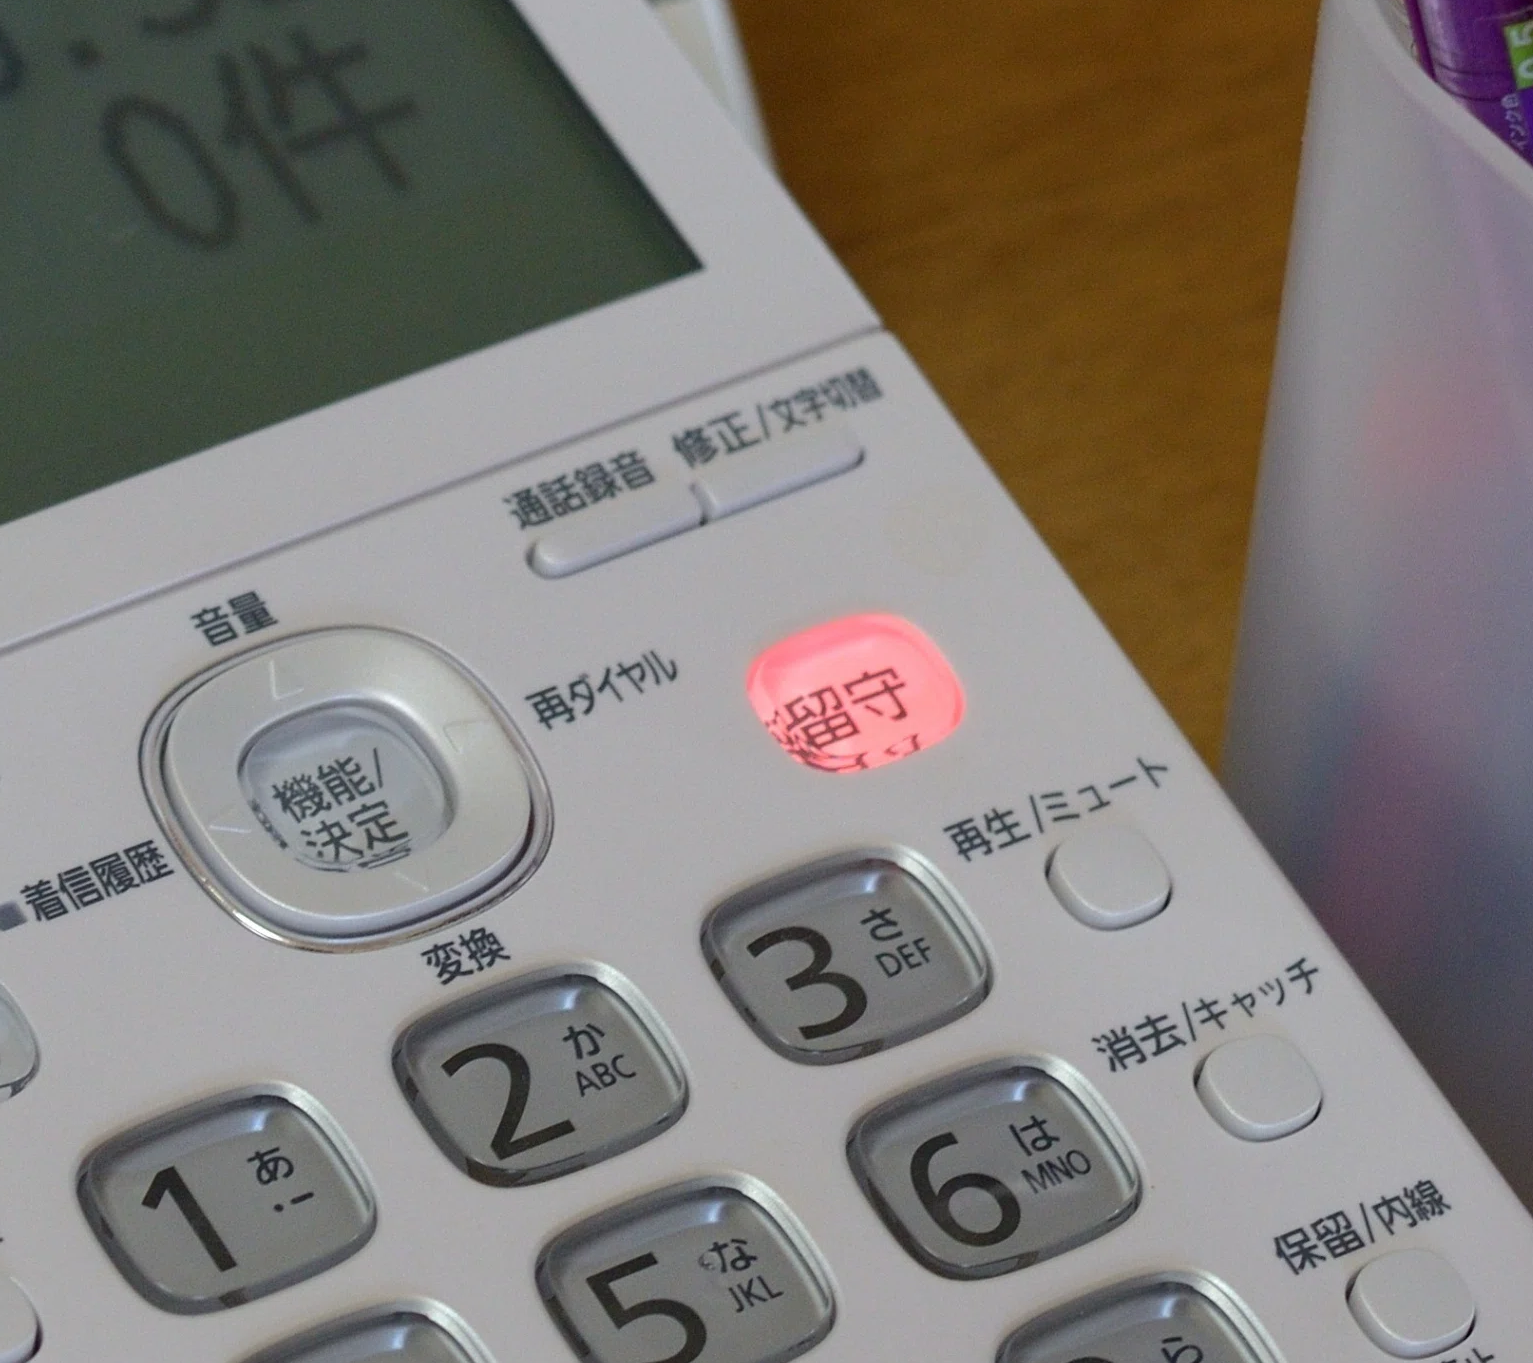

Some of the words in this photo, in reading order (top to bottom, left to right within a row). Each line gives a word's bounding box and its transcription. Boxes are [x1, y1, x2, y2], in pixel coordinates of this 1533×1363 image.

[108, 23, 417, 251] 0件
[503, 449, 656, 530] 通話録音
[191, 591, 277, 647] 音量
[526, 651, 680, 732] 再ダイヤル
[784, 668, 907, 749] 留守
[300, 800, 409, 861] 決定
[20, 840, 175, 923] 着信履歴
[860, 906, 904, 945] さ
[420, 927, 512, 987] 変換
[746, 926, 868, 1041] 3
[874, 937, 933, 978] DEF
[563, 1022, 605, 1061] か
[440, 1042, 576, 1162] 2
[574, 1054, 637, 1098] ABC
[1010, 1114, 1061, 1156] は
[247, 1147, 294, 1187] あ
[909, 1131, 1021, 1248] 6
[1023, 1148, 1092, 1195] MNO
[141, 1166, 237, 1272] 1
[713, 1237, 758, 1275] な
[727, 1276, 784, 1313] JKL
